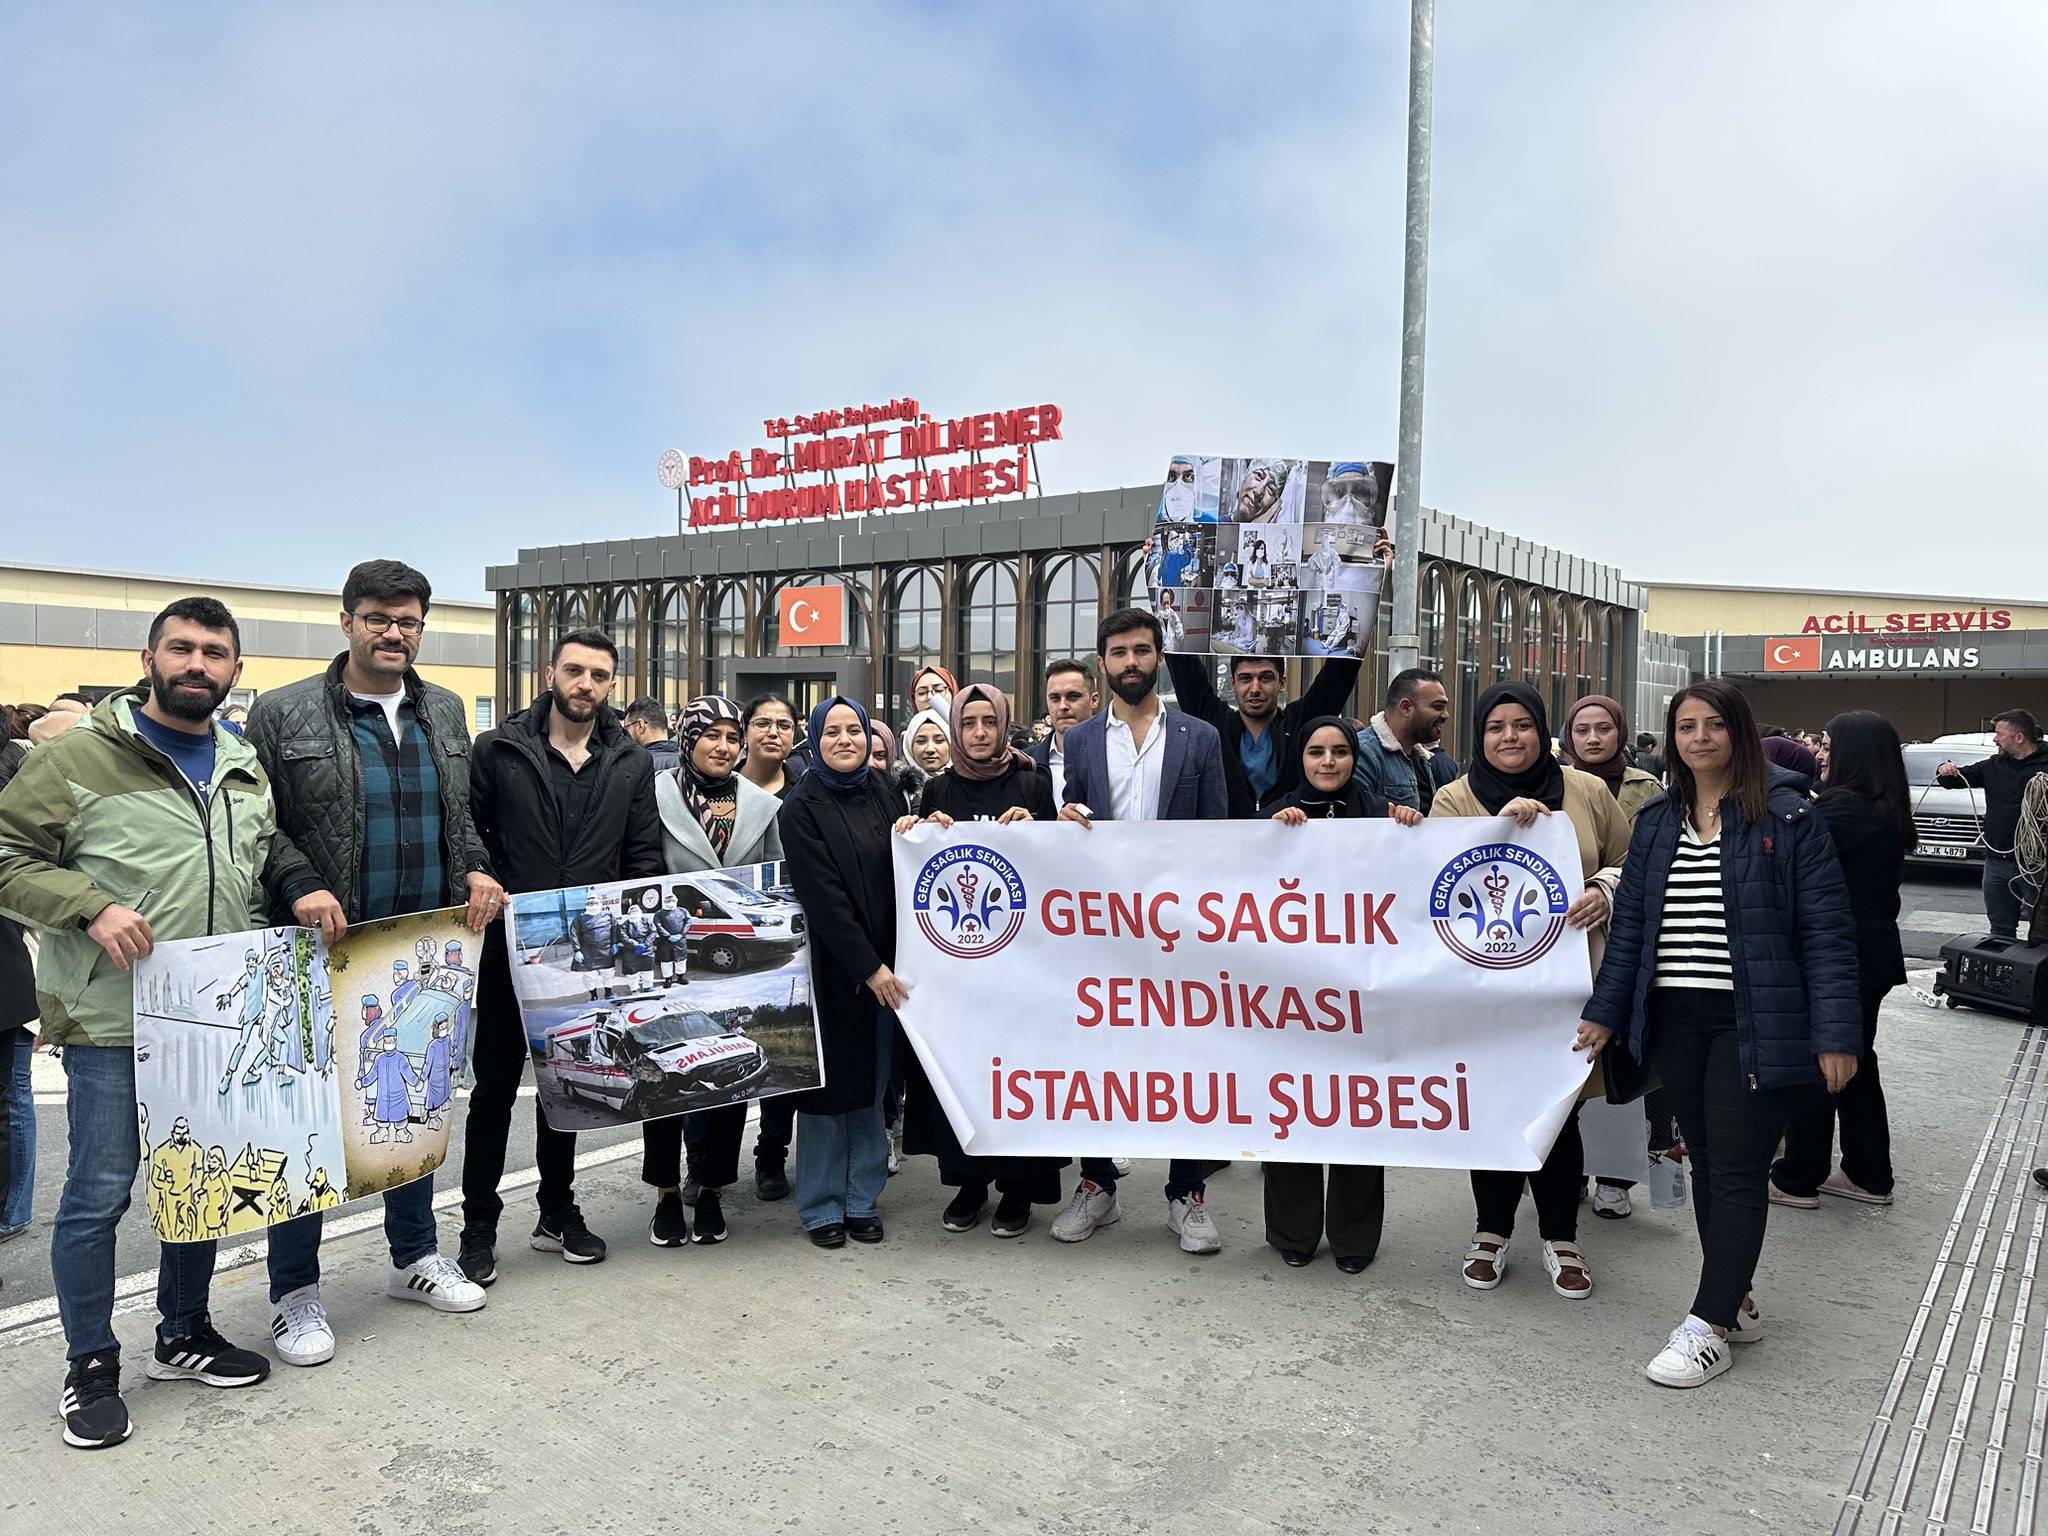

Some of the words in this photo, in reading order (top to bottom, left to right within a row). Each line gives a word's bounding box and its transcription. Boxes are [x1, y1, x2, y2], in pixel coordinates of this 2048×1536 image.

[689, 449, 747, 487] Prof.
[751, 447, 789, 479] Dr.
[794, 430, 889, 474] MURAT
[901, 403, 1063, 460] DİLMENER
[795, 410, 843, 435] Sağlık
[843, 397, 919, 427] Bakanlığı
[688, 486, 743, 527] ACİL
[747, 483, 839, 521] DURUM
[845, 446, 1028, 512] HASTANESİ
[1801, 611, 1874, 634] ACİL
[1885, 607, 2012, 632] SERVİS
[1827, 647, 1980, 670] AMBULANS
[917, 870, 936, 903] GENÇ
[931, 847, 974, 871] SAĞLIK
[976, 849, 1023, 903] SENDİKASI
[1434, 871, 1458, 910] GENÇ
[1453, 847, 1503, 873] SAĞLIK
[1505, 847, 1564, 906] SENDİKASI
[957, 934, 984, 944] 2022
[1041, 889, 1181, 953] GENÇ
[1198, 878, 1399, 946] SAĞLIK
[1484, 942, 1517, 953] 2022
[1076, 971, 1364, 1035] SENDİKASI
[991, 1057, 1252, 1126] İSTANBUL
[1269, 1062, 1471, 1141] ŞUBESİ
